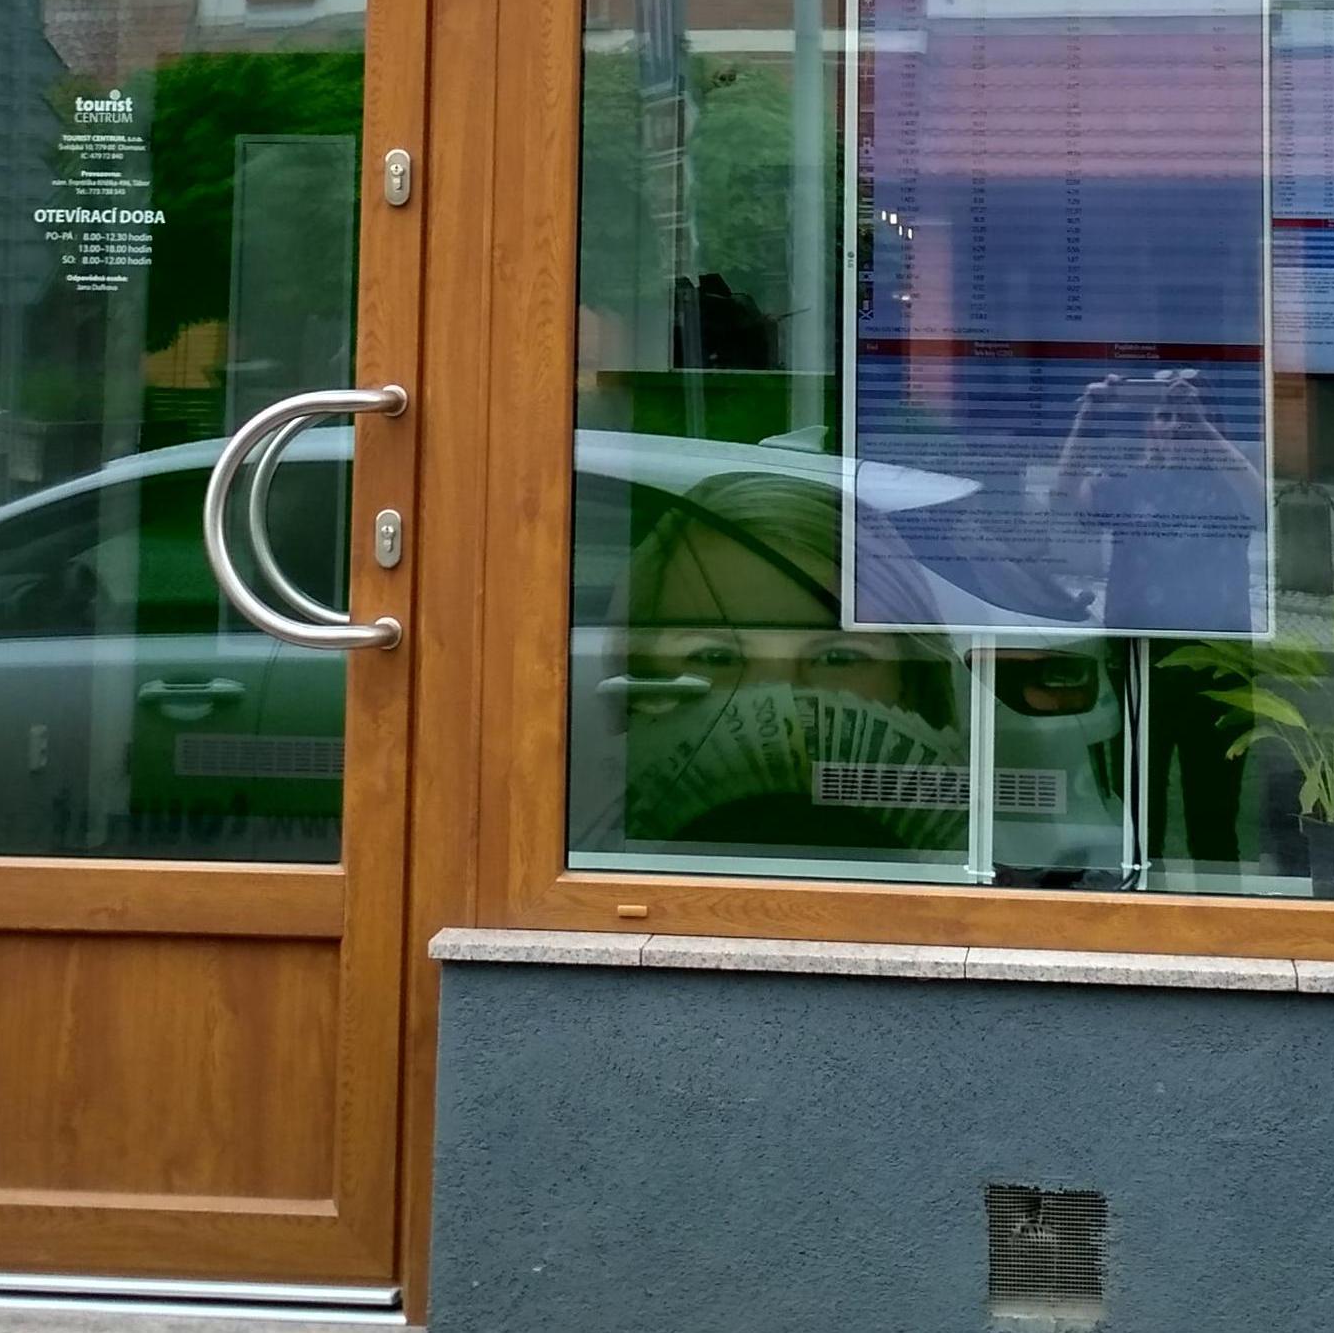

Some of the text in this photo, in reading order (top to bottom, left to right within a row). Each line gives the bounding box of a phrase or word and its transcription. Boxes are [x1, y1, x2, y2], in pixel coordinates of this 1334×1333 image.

[75, 96, 133, 113] tourist
[74, 113, 133, 124] CENTRUM
[34, 207, 166, 224] OTEVÍRACÍ DOBA
[128, 233, 153, 241] hodin
[128, 245, 152, 253] hodin
[127, 256, 152, 265] hodin
